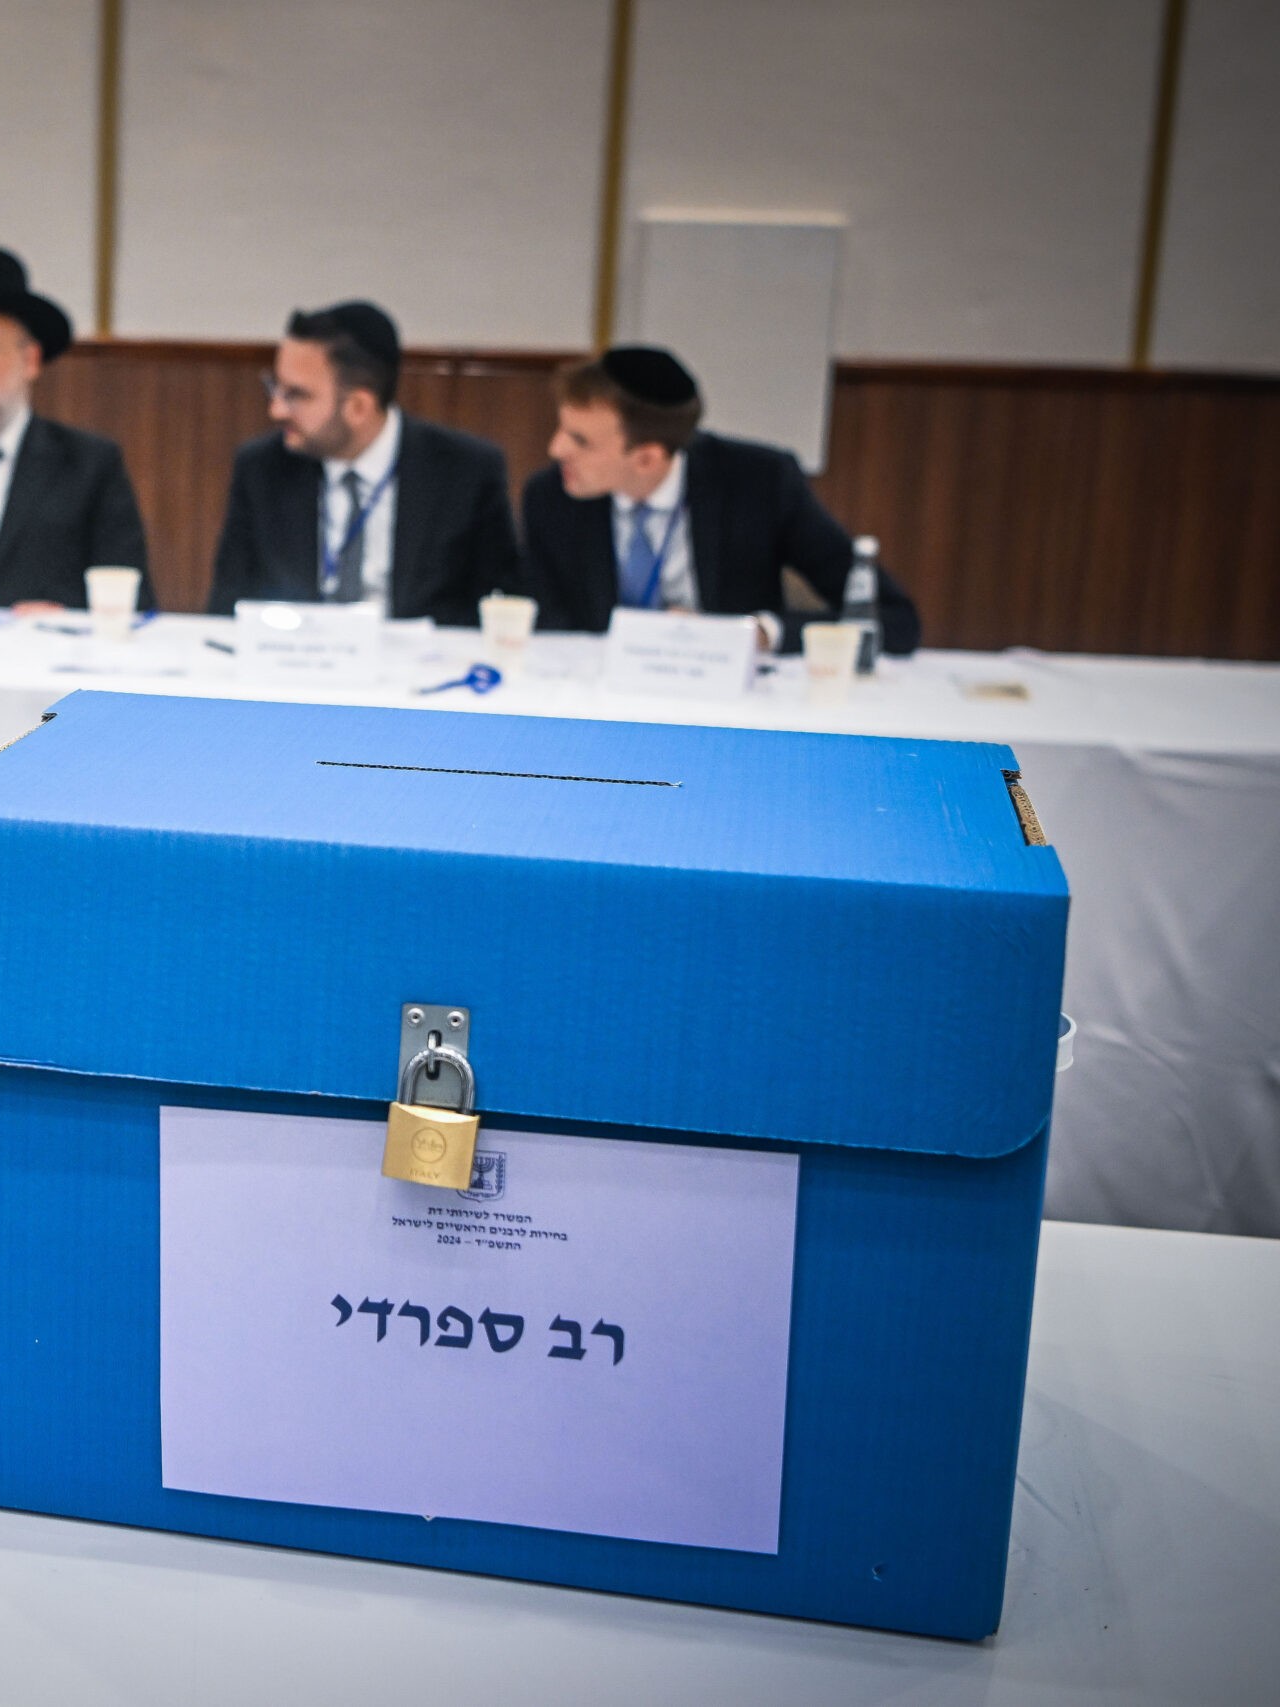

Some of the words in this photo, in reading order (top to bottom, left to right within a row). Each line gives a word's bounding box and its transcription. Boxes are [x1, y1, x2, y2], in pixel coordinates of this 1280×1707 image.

[427, 1206, 443, 1217] דת
[445, 1208, 490, 1221] לשירותי
[492, 1212, 533, 1224] המשרד
[391, 1215, 433, 1229] לישראל
[436, 1220, 486, 1234] הראשיים
[489, 1225, 527, 1238] לרבנים
[529, 1229, 568, 1242] בחירות
[436, 1233, 462, 1246] 2024
[329, 1293, 526, 1354] ספרדי
[546, 1313, 626, 1367] רב
